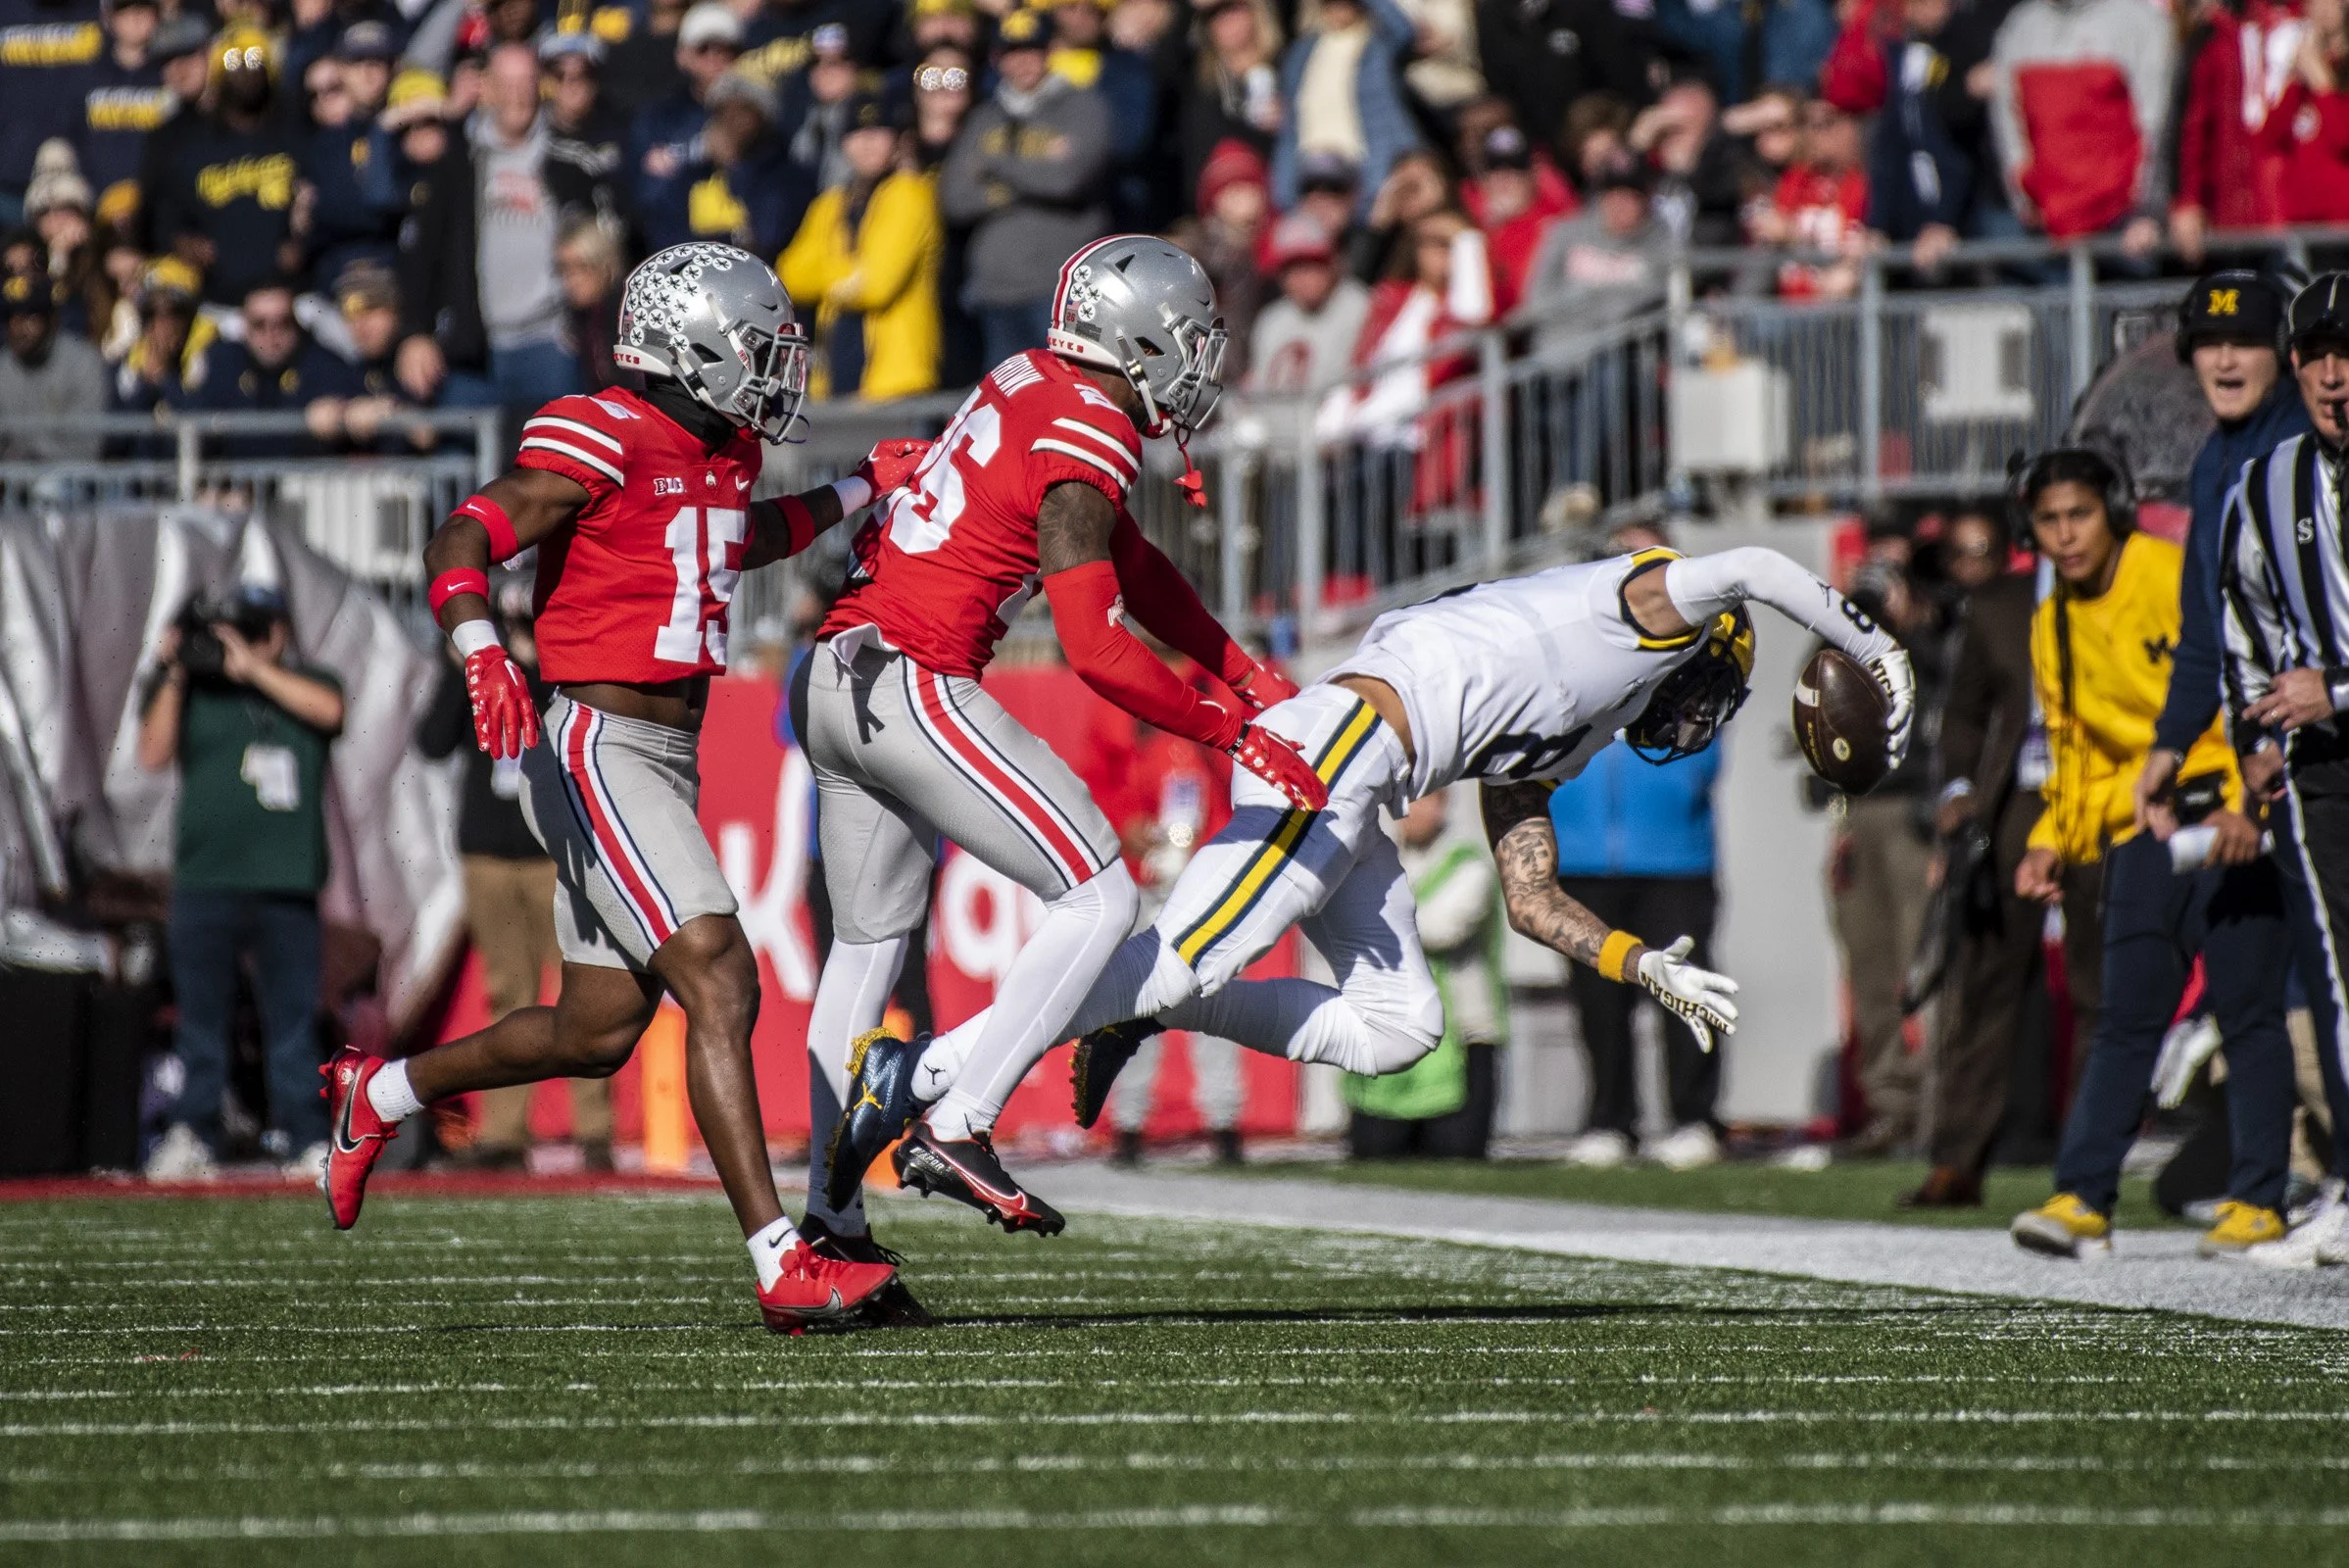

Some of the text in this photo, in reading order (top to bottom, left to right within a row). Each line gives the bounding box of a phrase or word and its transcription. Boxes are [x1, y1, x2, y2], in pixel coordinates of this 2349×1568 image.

[2207, 288, 2241, 317] M
[2297, 516, 2314, 545] S
[654, 506, 745, 665] 15
[1841, 596, 1877, 634] 8
